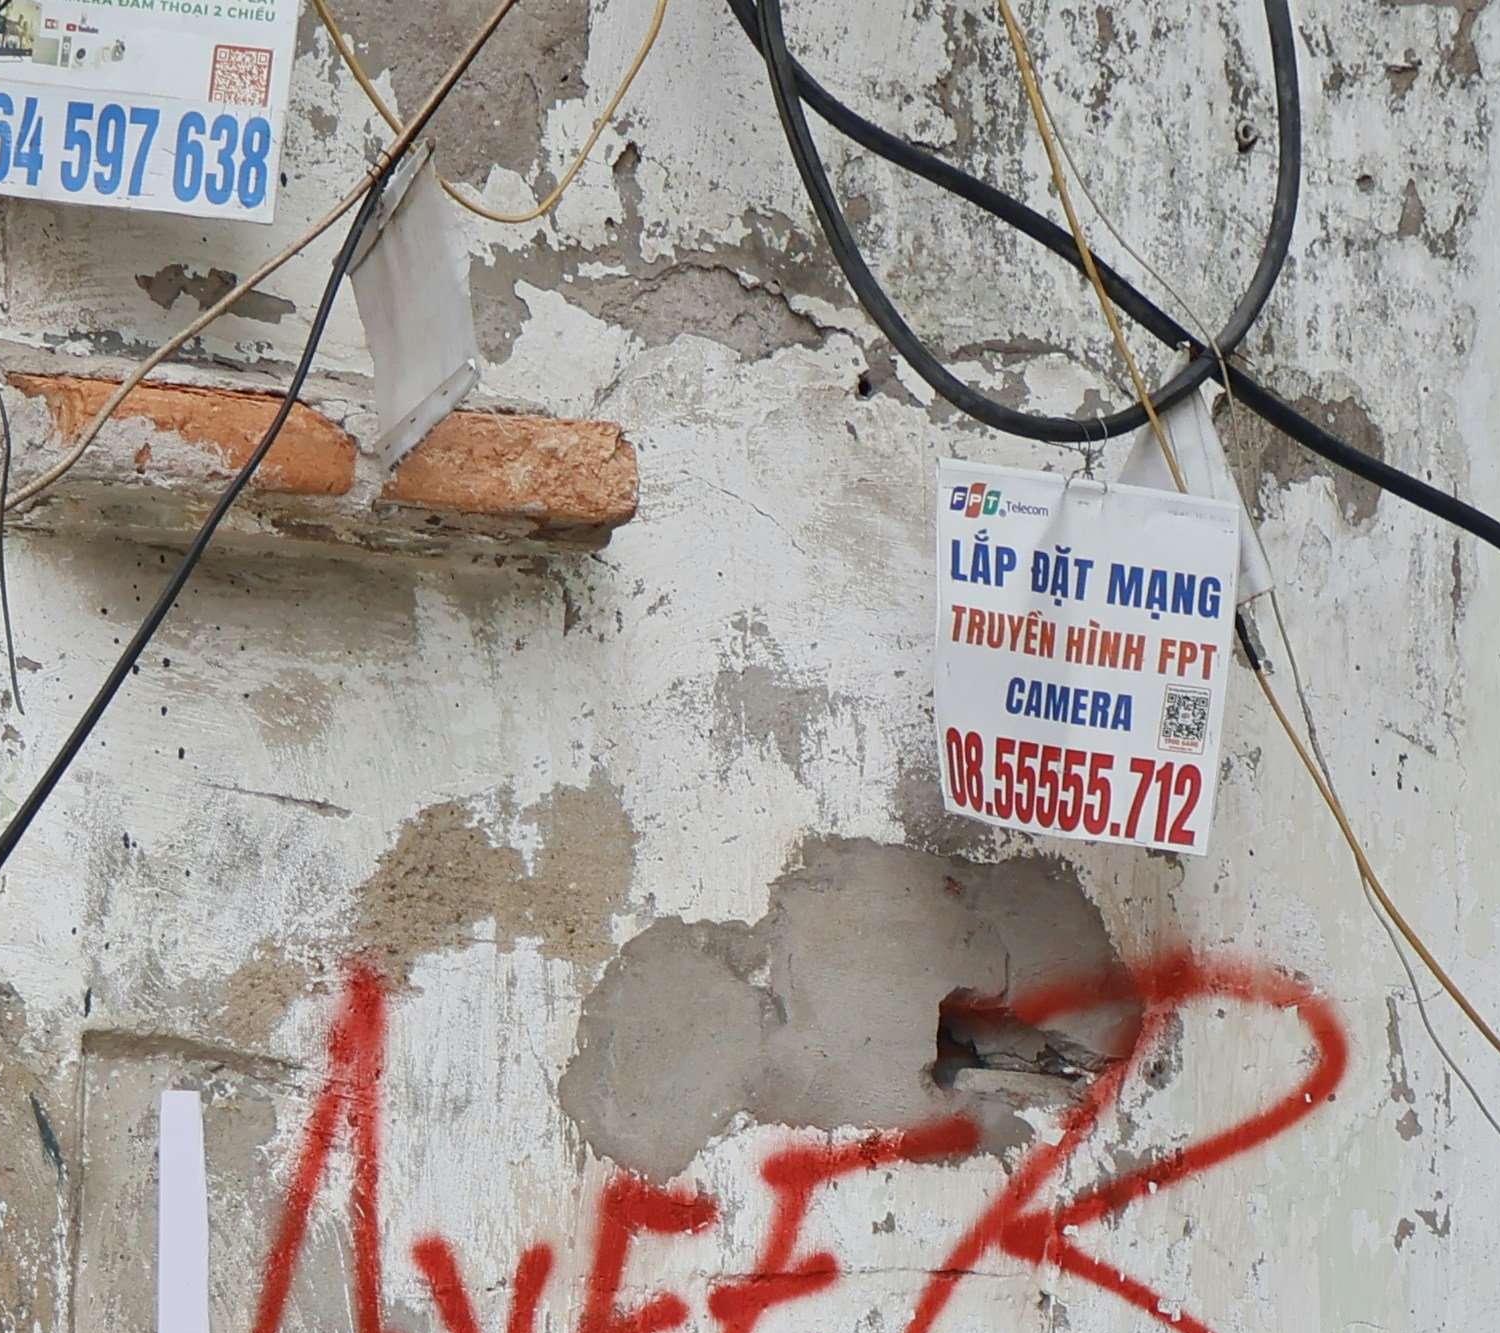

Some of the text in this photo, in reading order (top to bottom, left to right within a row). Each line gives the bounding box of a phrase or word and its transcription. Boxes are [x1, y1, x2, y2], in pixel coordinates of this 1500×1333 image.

[60, 102, 160, 196] 597
[173, 110, 272, 209] 638
[950, 485, 1049, 517] FPT Telecom
[951, 529, 1221, 620] LẮP ĐẶT MẠNG
[951, 606, 1217, 680] TRUYỀN HÌNH FPT
[1005, 677, 1133, 731] CAMERA
[946, 727, 1201, 845] 08.55555.712
